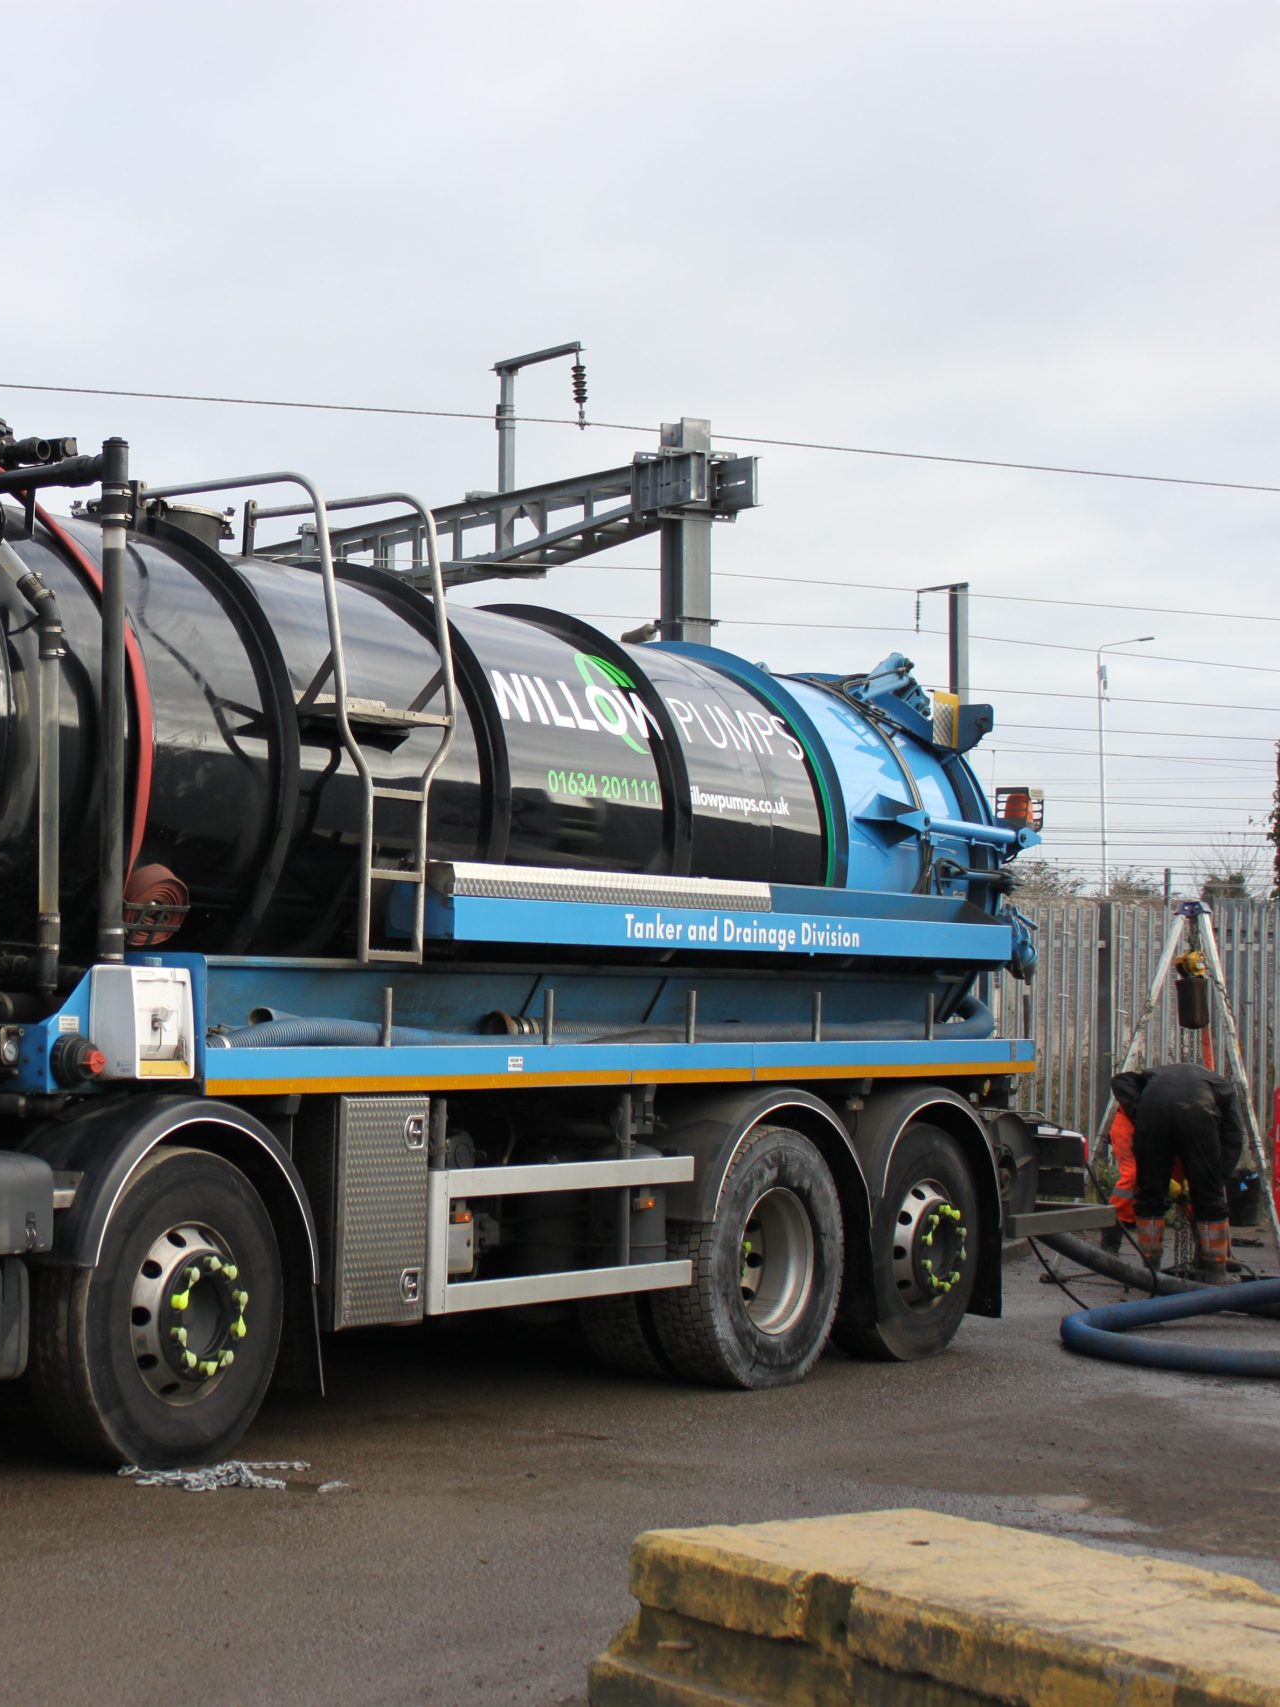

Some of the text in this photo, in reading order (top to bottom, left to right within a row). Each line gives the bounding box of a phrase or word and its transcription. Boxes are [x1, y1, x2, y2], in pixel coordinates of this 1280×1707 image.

[490, 669, 805, 761] WILLOW PUMPS
[548, 769, 660, 803] 01634 201111
[690, 785, 791, 816] illowpumps.co.uk
[625, 914, 860, 951] Tanker and Drainage Division
